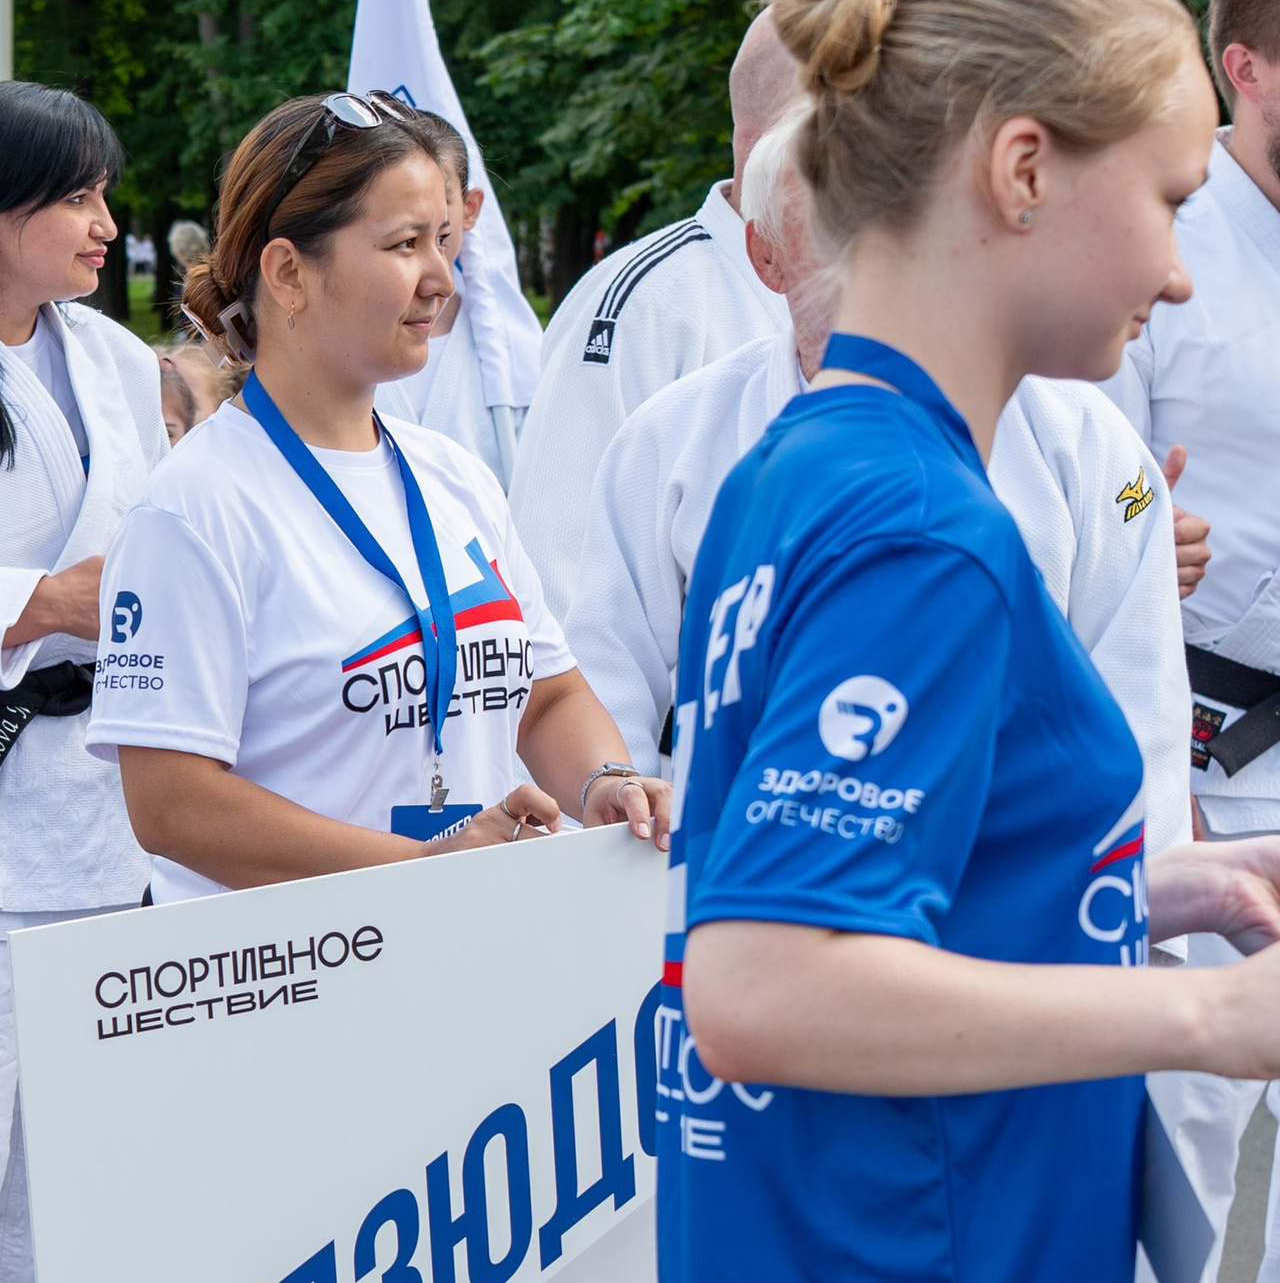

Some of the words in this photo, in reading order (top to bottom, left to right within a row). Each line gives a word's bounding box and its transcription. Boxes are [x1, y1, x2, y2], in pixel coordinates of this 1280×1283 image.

[584, 344, 610, 356] adidas
[758, 767, 926, 814] ЗДОРОВОЕ
[745, 798, 905, 845] ОТЕЧЕСТВО
[96, 978, 320, 1030] ШЕСТВИЕ
